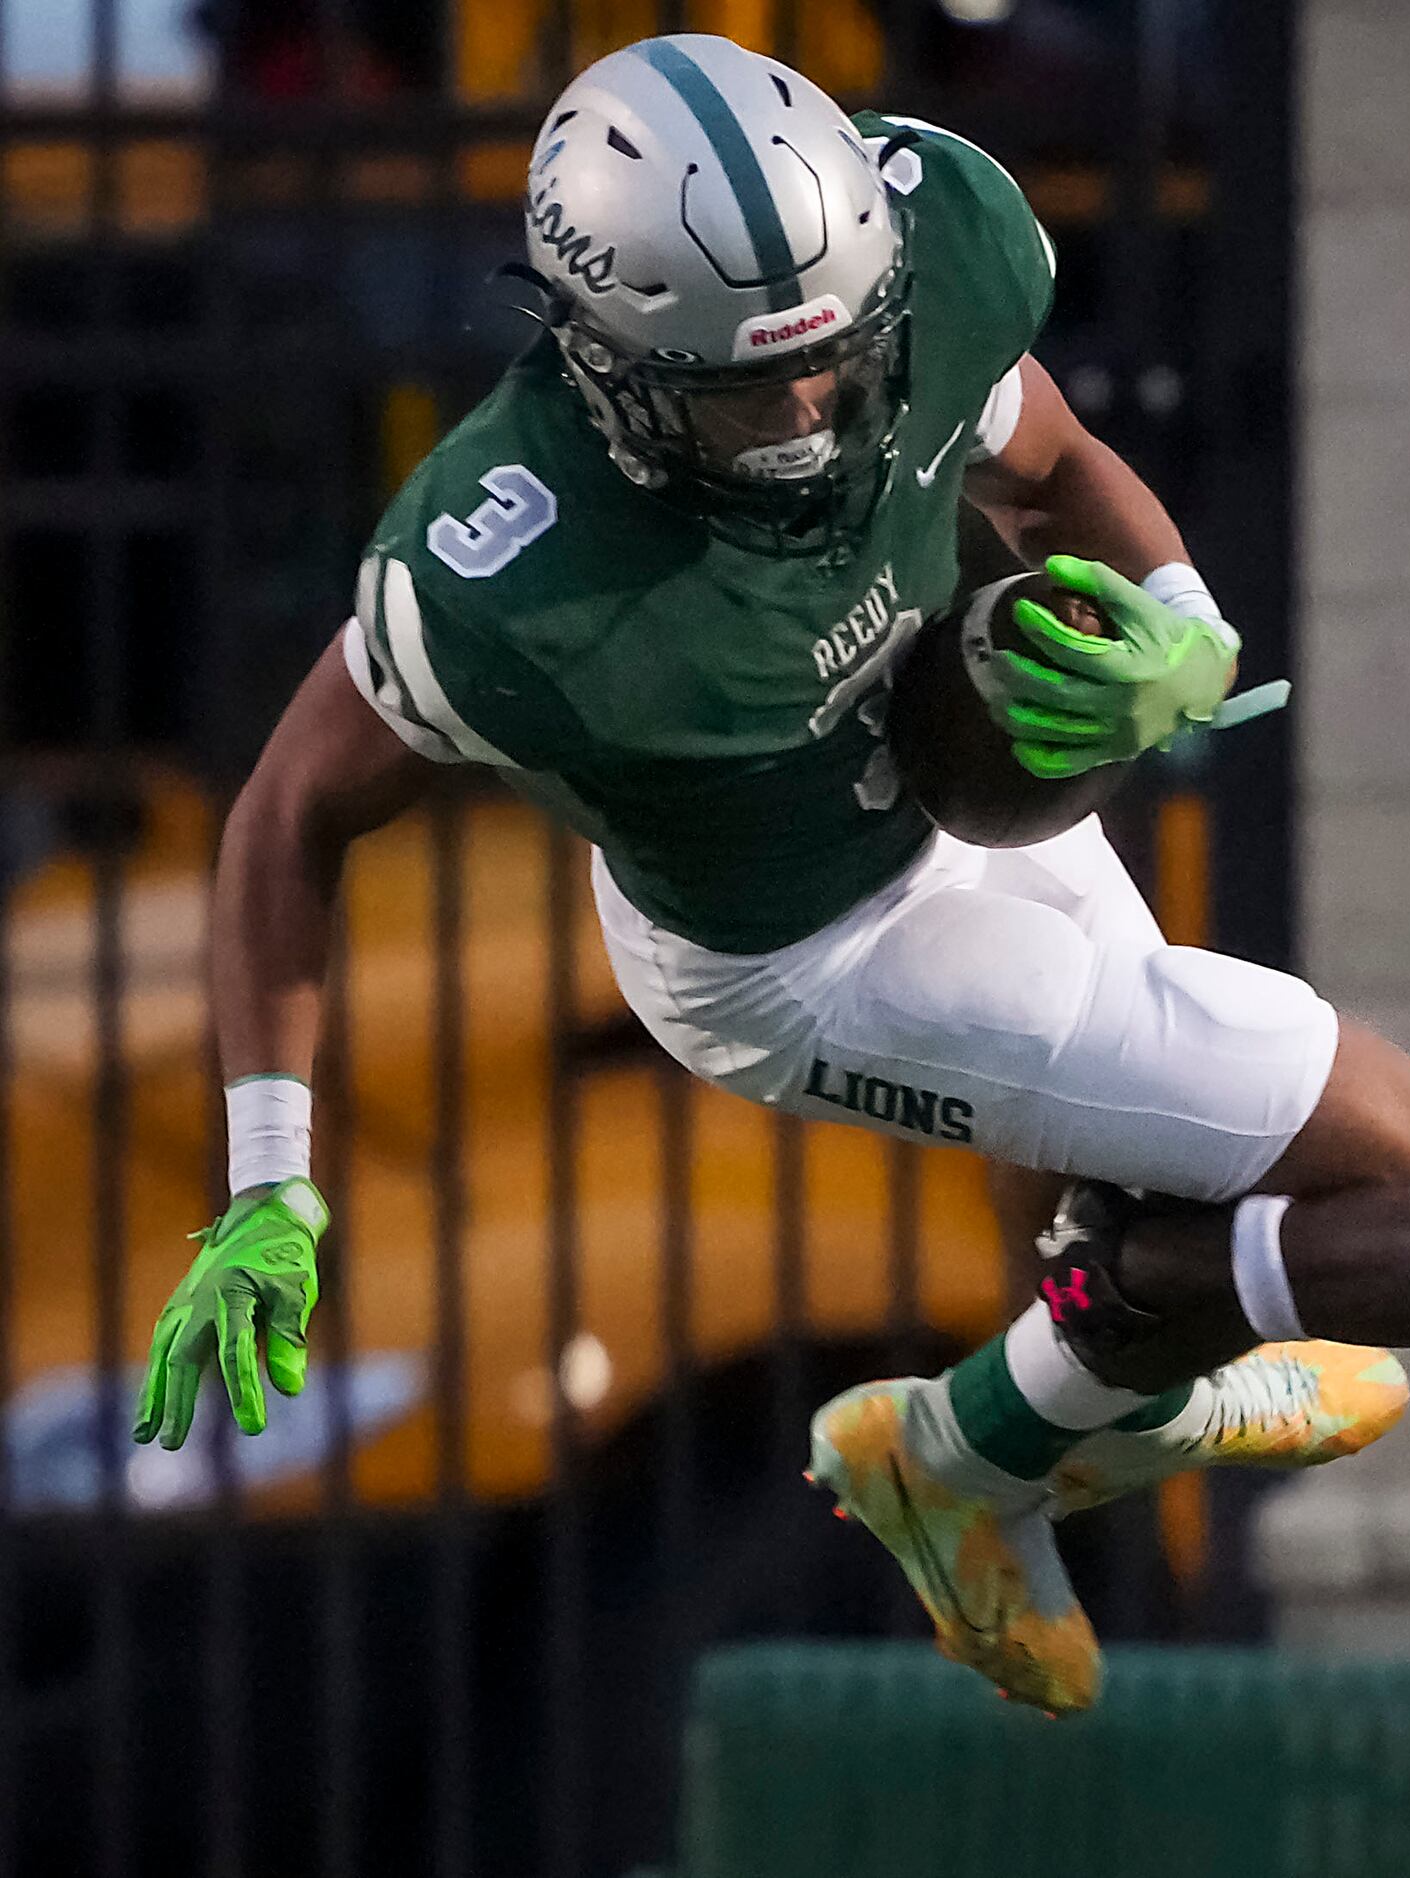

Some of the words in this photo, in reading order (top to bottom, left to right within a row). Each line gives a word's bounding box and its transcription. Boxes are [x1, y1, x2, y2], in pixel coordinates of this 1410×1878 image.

[750, 308, 836, 346] Riddell
[426, 463, 559, 579] 3
[811, 561, 899, 679] REEDY
[804, 1058, 976, 1143] LIONS
